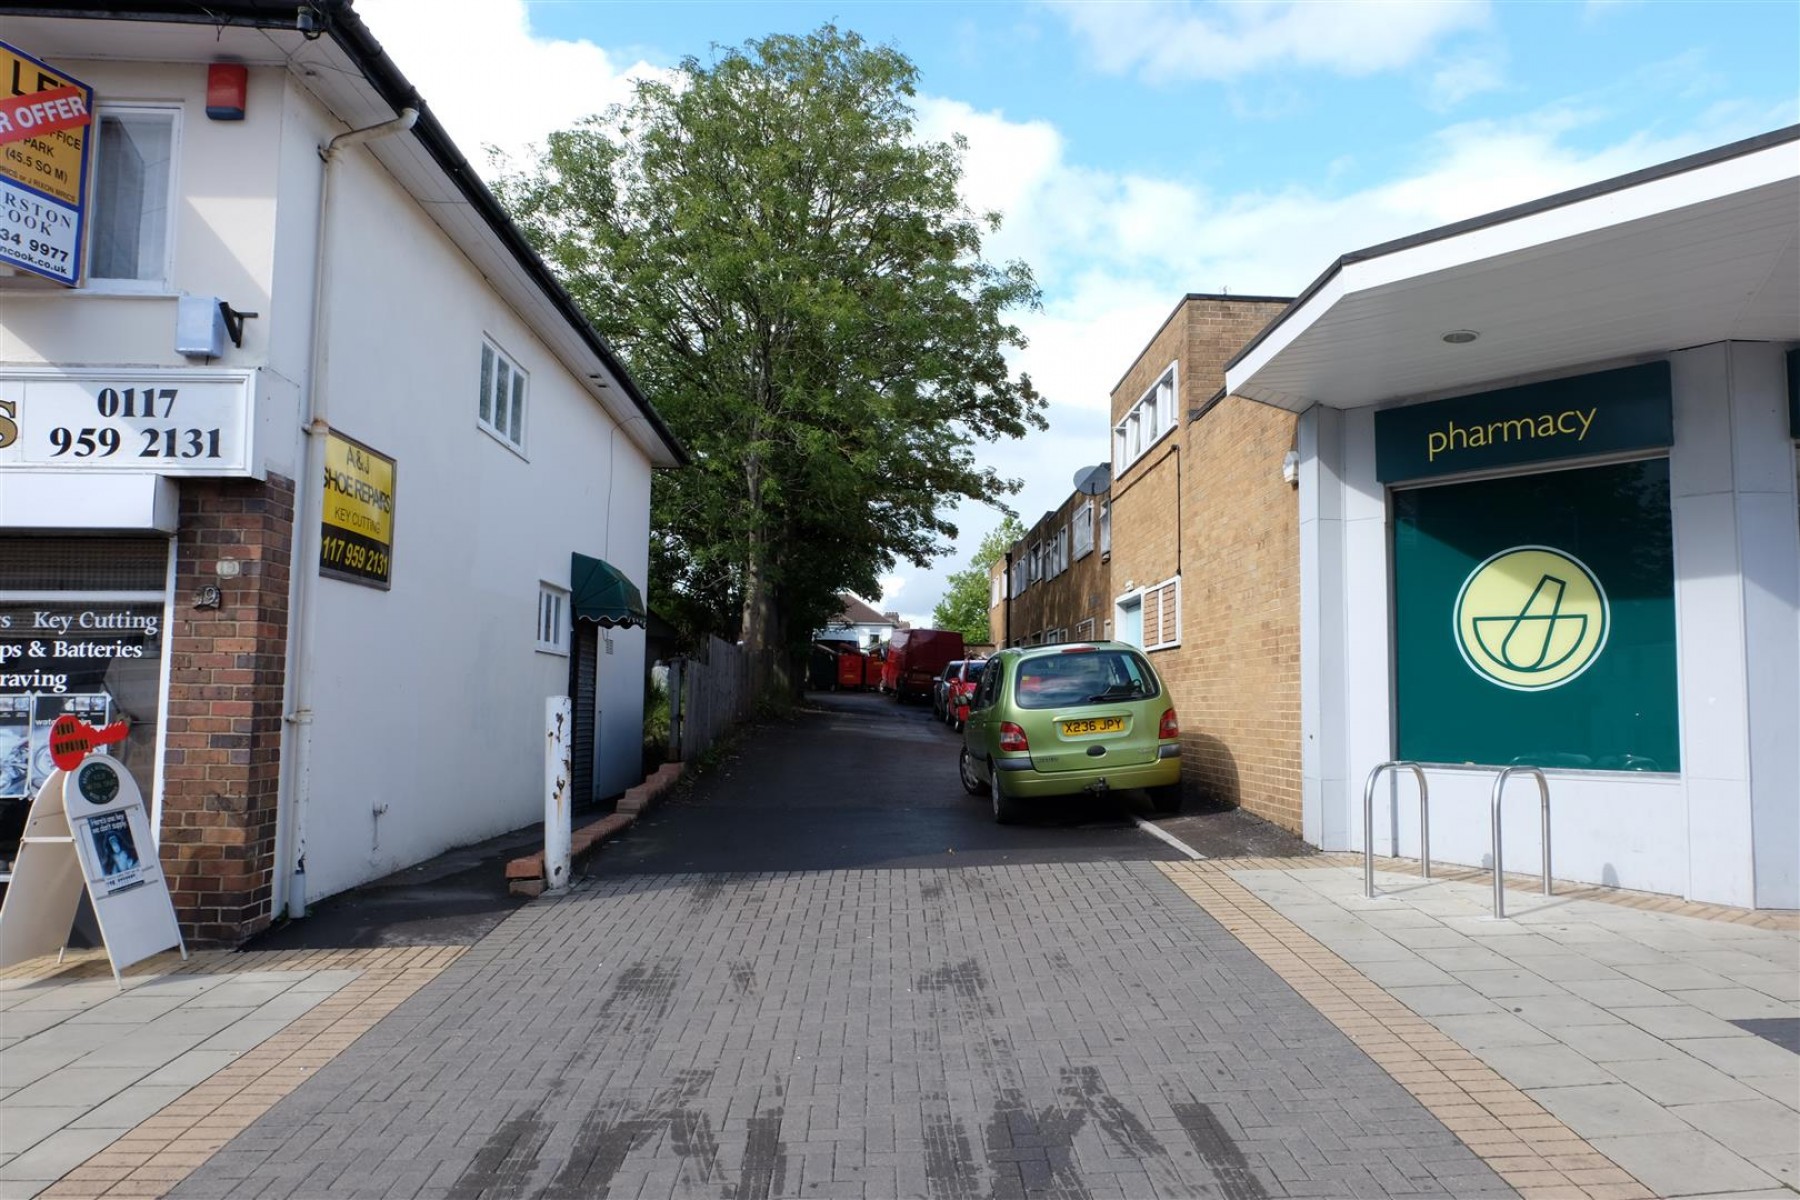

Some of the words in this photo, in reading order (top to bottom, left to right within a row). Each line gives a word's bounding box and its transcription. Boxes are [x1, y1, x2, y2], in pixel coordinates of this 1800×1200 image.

[11, 60, 82, 97] LE
[15, 96, 88, 129] OFFER
[23, 137, 55, 158] PARK
[29, 238, 69, 264] 9977
[97, 387, 178, 419] 0117
[49, 427, 121, 458] 959
[138, 427, 222, 458] 2131
[1428, 407, 1598, 463] pharmacy
[354, 480, 390, 514] REPAIRS
[335, 506, 351, 522] KEY
[351, 512, 381, 535] CUTTING
[321, 535, 345, 563] 117
[345, 542, 366, 570] 959
[366, 549, 388, 577] 2131
[32, 611, 74, 635] Key
[78, 611, 159, 636] Cutting
[28, 640, 47, 658] &
[52, 639, 143, 659] Batteries
[1065, 720, 1096, 733] X236
[1099, 719, 1122, 730] JPY
